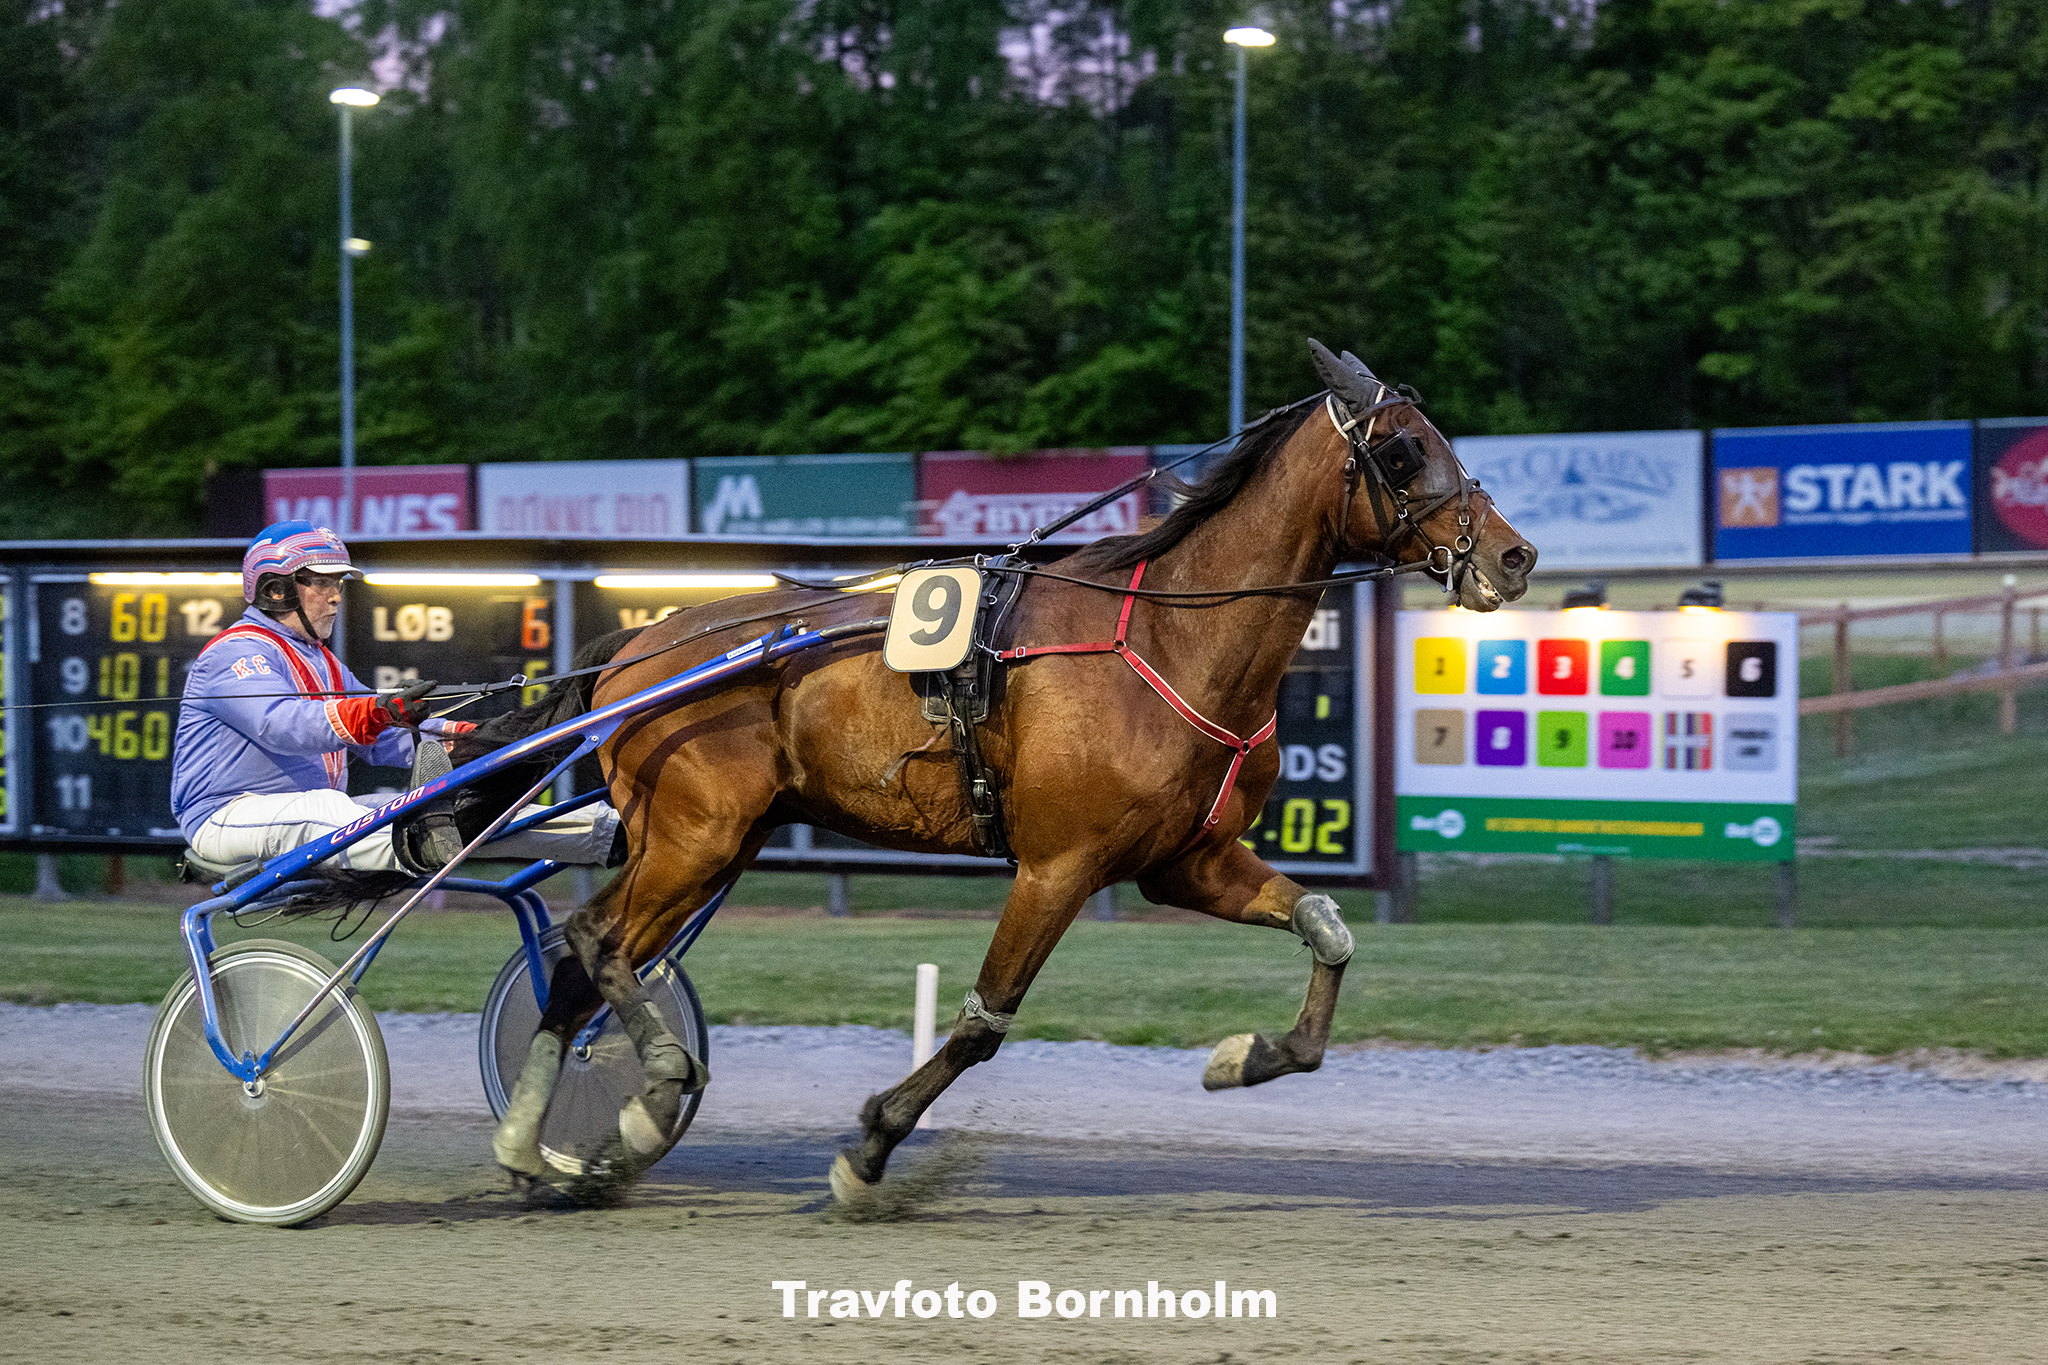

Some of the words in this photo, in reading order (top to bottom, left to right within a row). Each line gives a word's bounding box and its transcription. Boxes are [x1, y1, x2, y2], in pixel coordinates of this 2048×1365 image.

[1786, 461, 1966, 510] STARK
[275, 494, 459, 533] VANES
[60, 599, 87, 635] 8
[111, 592, 168, 642] 60
[179, 599, 223, 636] 12
[373, 604, 454, 641] LØB
[521, 598, 549, 649] 6
[909, 575, 962, 646] 9
[61, 656, 89, 694] 9
[231, 653, 271, 682] KC
[1433, 656, 1447, 677] 1
[1491, 655, 1512, 679] 2
[1553, 655, 1573, 680] 3
[1615, 655, 1636, 680] 4
[1680, 658, 1695, 679] 5
[1740, 656, 1761, 682] 6
[50, 714, 89, 752] 10
[88, 711, 170, 760] 460
[1434, 726, 1448, 748] 7
[1491, 726, 1512, 750] 8
[1555, 728, 1571, 750] 9
[1612, 729, 1638, 752] 10
[56, 774, 92, 810] 11
[330, 785, 426, 845] CUSTOM
